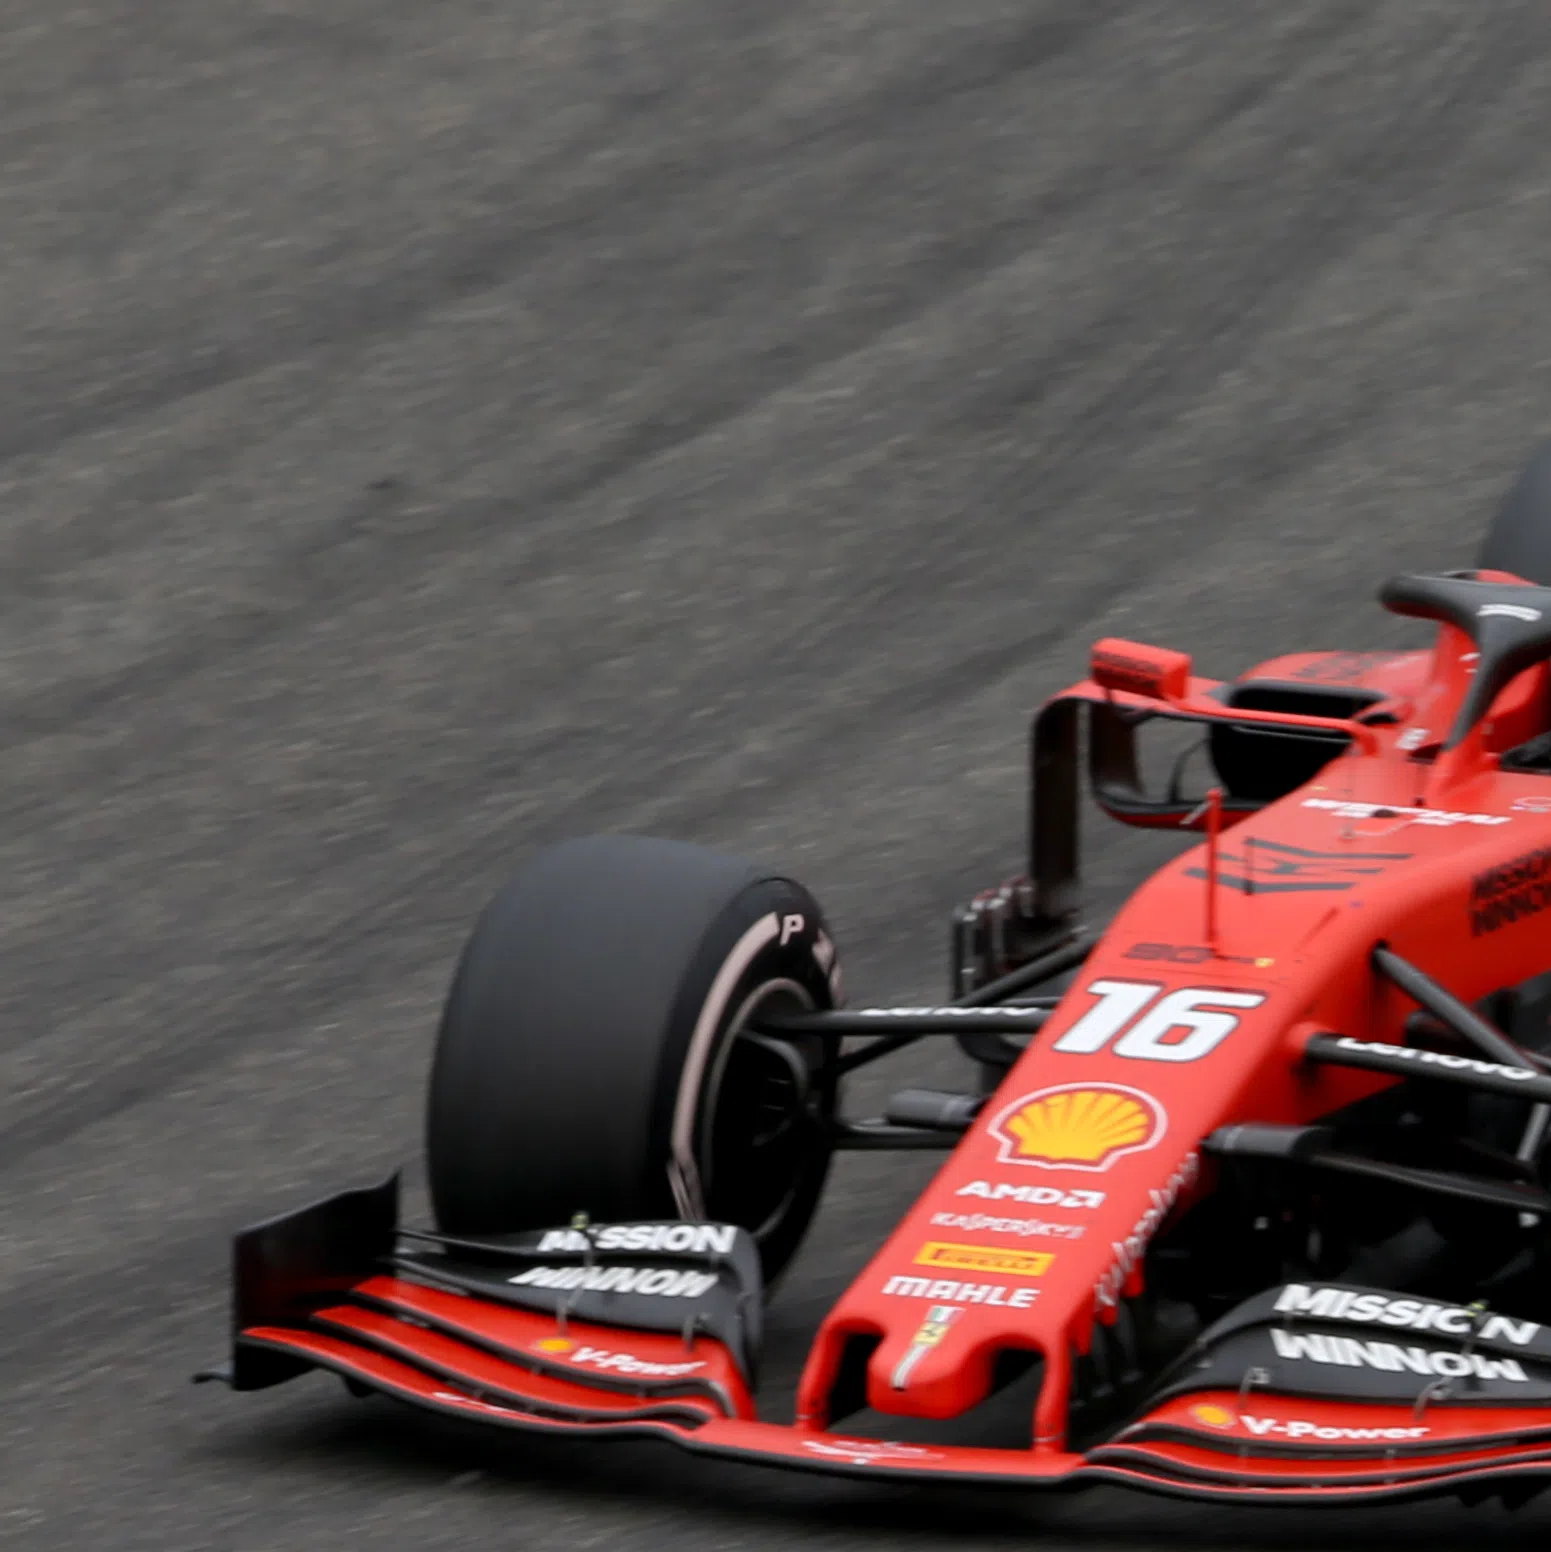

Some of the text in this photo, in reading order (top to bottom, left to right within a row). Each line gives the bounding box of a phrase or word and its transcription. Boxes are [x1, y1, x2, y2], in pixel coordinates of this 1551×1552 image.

[1052, 976, 1268, 1064] 16
[956, 1180, 1066, 1207] AMD
[537, 1225, 738, 1253] MSSION
[1270, 1328, 1529, 1382] WINNOW
[1240, 1414, 1431, 1440] V-Power
